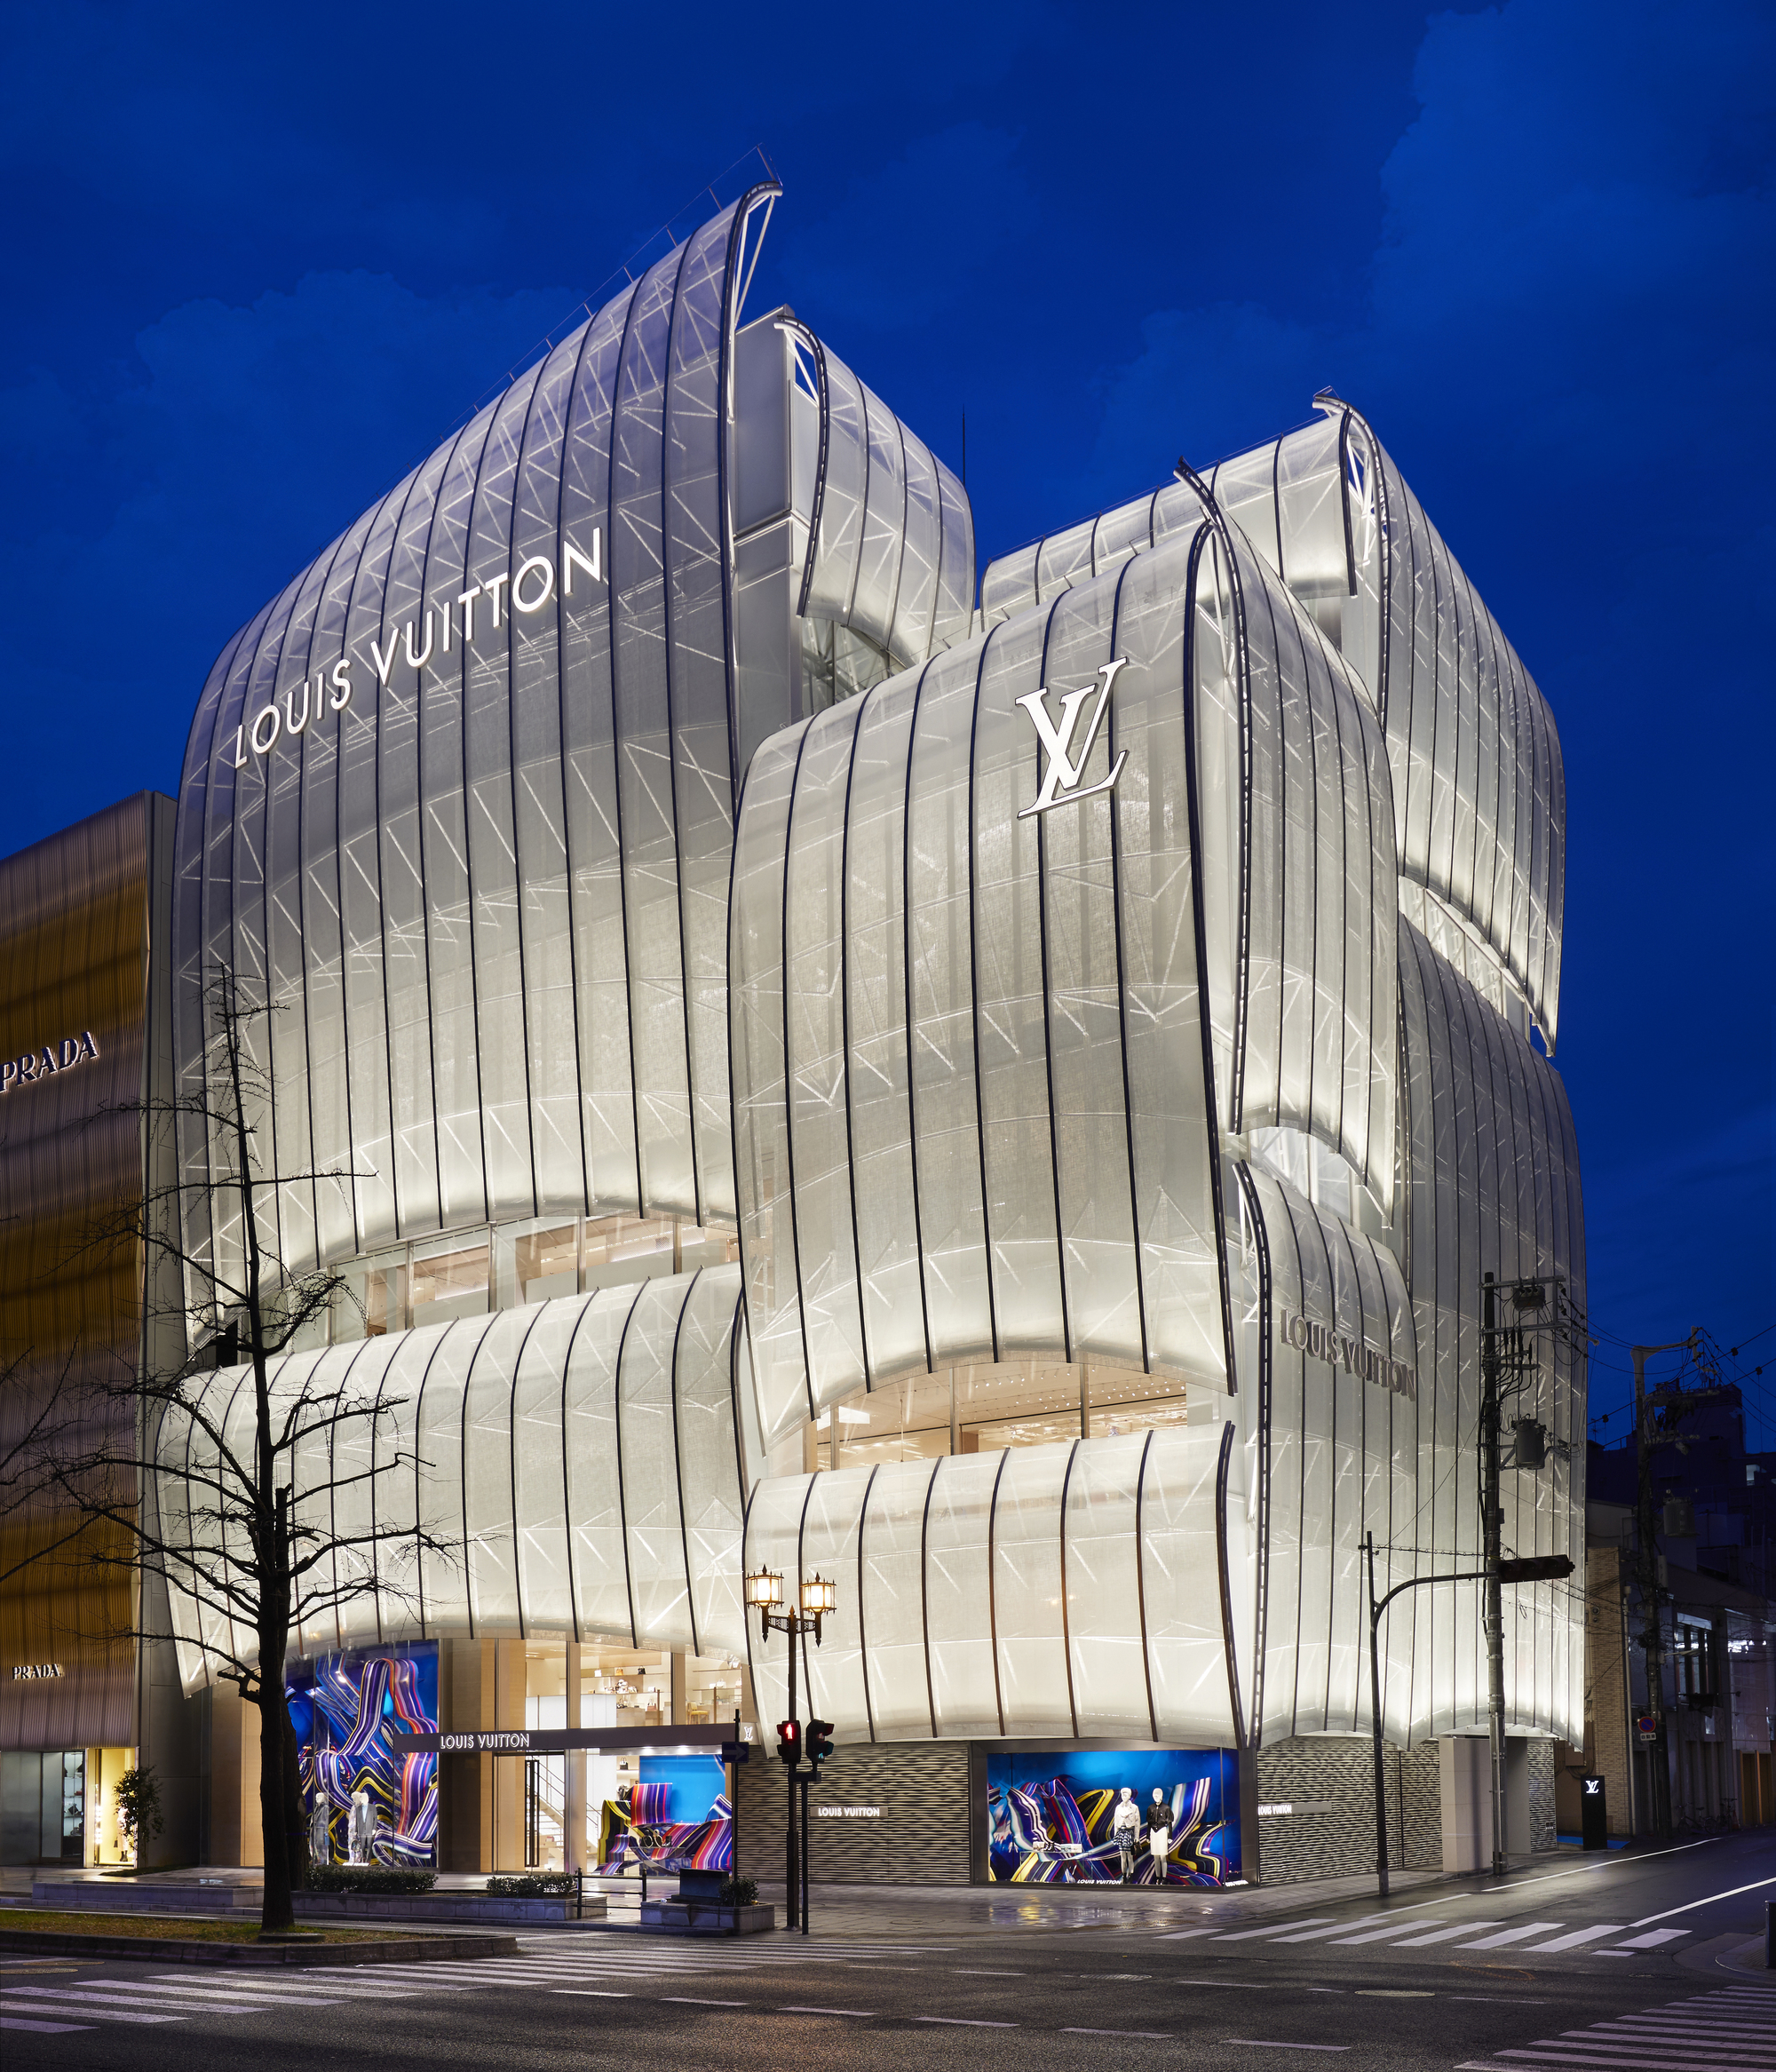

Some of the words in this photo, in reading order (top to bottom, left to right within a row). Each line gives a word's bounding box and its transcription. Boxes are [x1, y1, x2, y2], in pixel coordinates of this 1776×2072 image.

[235, 659, 353, 770] LOUIS
[370, 527, 603, 687] VUITTON
[0, 1031, 99, 1093] PRADA
[1280, 1309, 1338, 1365] LOUIS
[1341, 1338, 1416, 1401] VUITTON
[12, 1663, 60, 1680] PRADA
[440, 1735, 474, 1749] LOUIS
[477, 1733, 530, 1748] VUITTON
[818, 1807, 842, 1816] LOUIS
[844, 1807, 880, 1816] VUITTON
